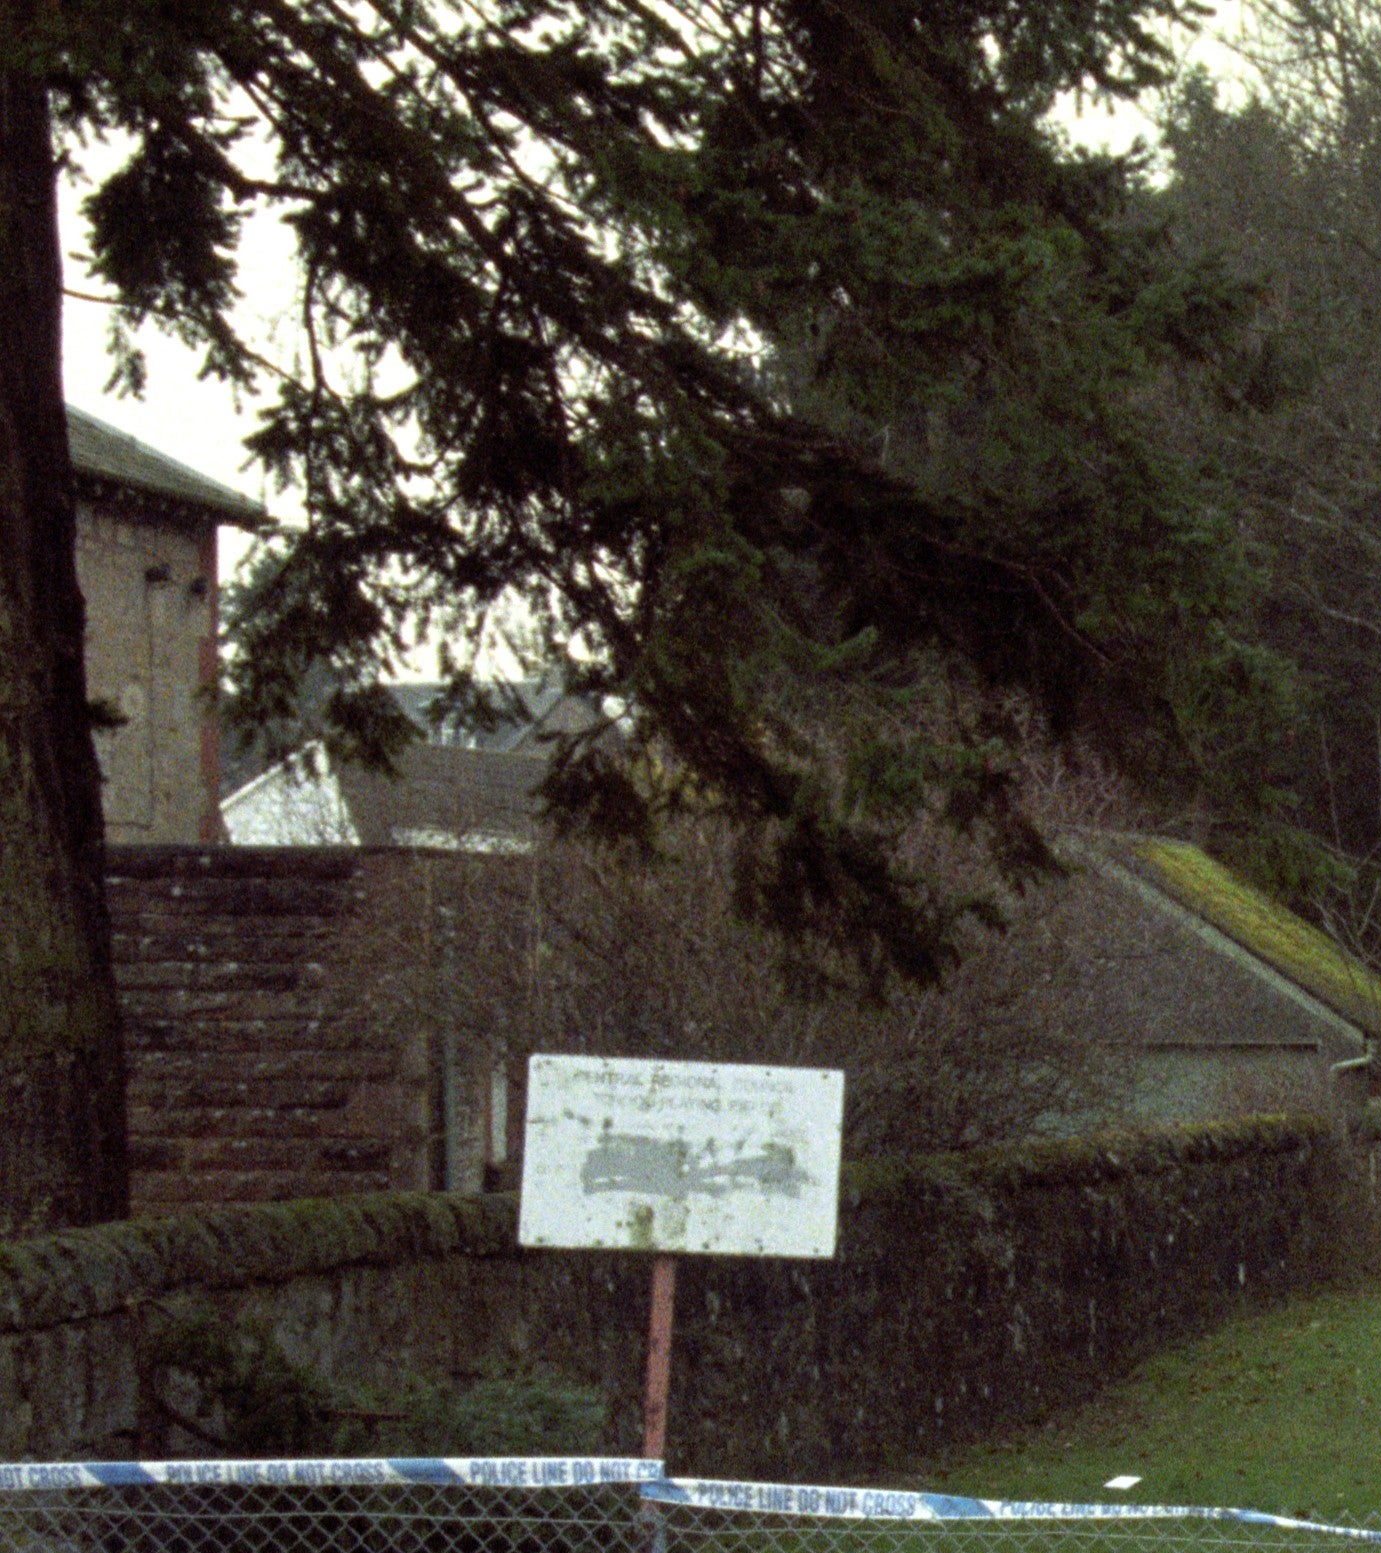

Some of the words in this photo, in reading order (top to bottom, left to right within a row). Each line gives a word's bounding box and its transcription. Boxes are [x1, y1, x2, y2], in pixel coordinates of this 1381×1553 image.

[28, 1466, 82, 1488] CROSS
[165, 1462, 222, 1484] POLICE
[226, 1462, 260, 1484] LINE
[266, 1462, 289, 1483] DO
[294, 1462, 326, 1483] NOT
[331, 1461, 385, 1482] CROSS
[469, 1460, 527, 1484] POLICE
[532, 1460, 567, 1484] LINE
[570, 1460, 594, 1483] DO
[599, 1460, 630, 1482] NOT
[696, 1482, 753, 1510] POLICE
[757, 1487, 793, 1511] LINE
[797, 1488, 822, 1513] DO
[825, 1490, 857, 1515] NOT
[861, 1492, 917, 1517] CROSS
